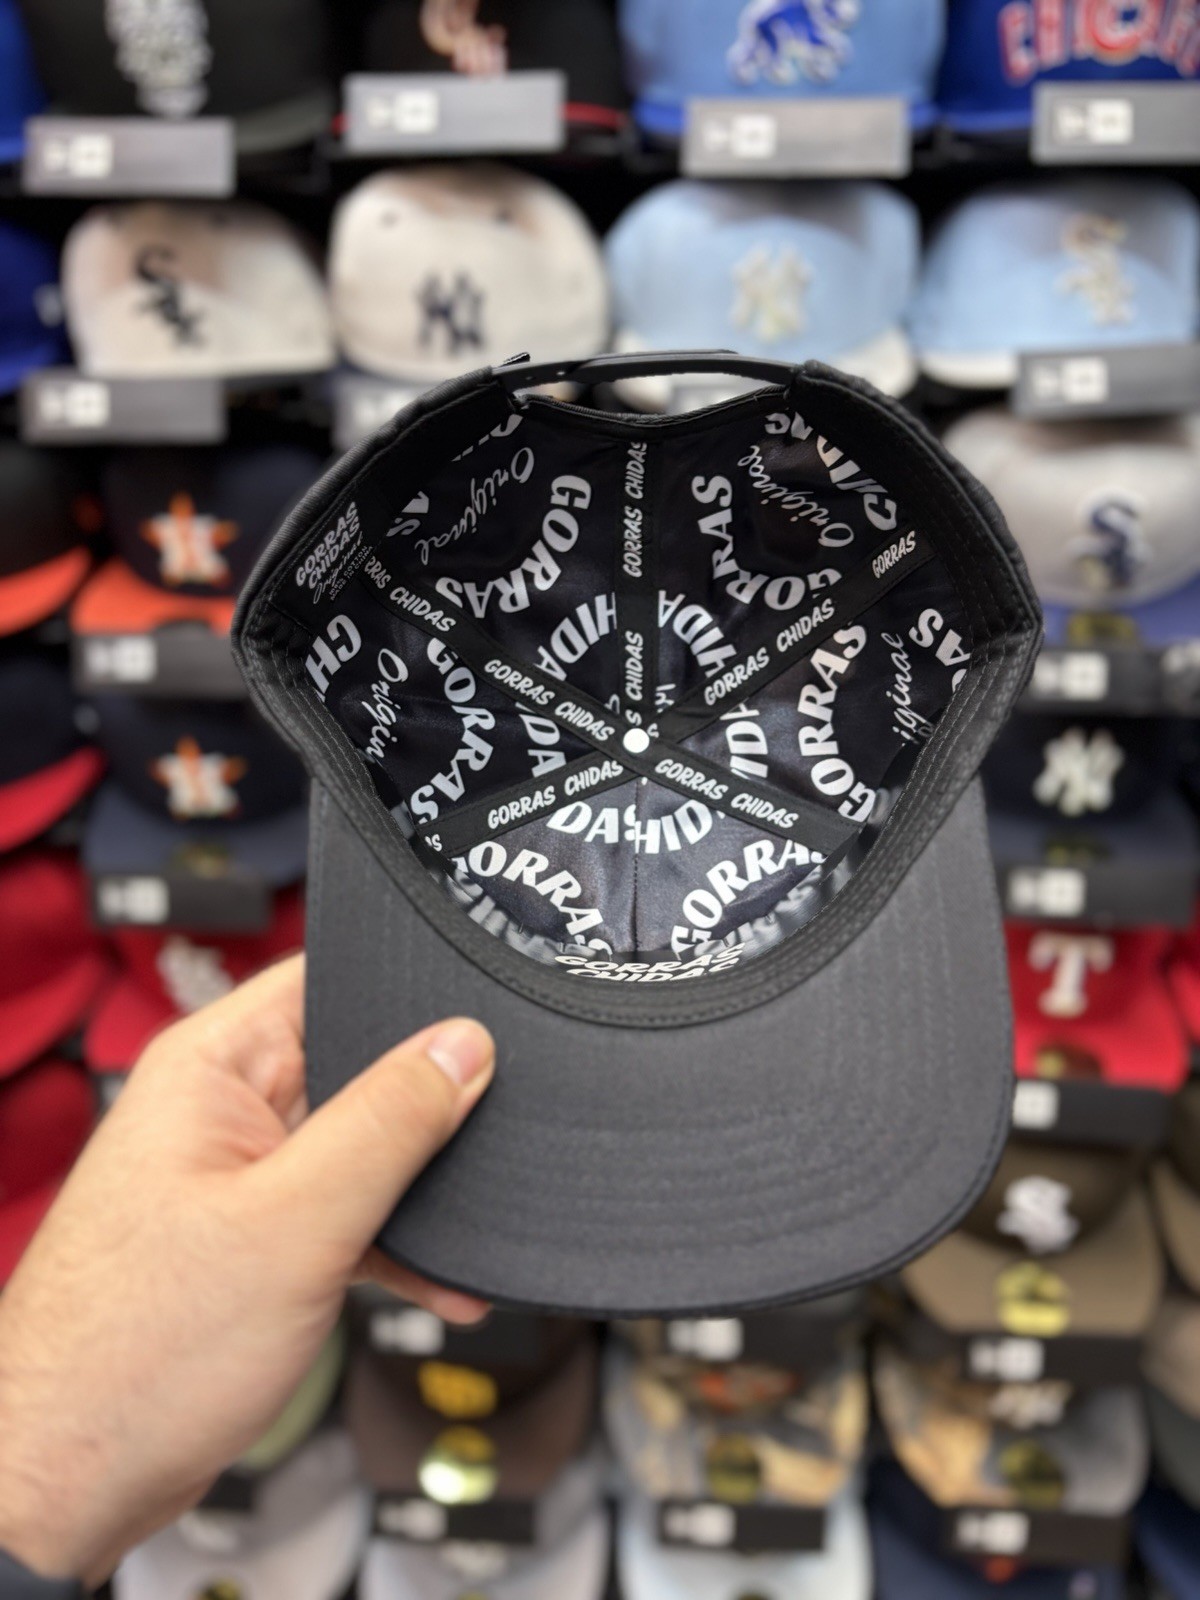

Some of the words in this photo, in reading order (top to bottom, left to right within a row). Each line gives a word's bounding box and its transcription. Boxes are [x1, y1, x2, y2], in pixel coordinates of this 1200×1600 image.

[414, 447, 535, 566] Original
[623, 441, 649, 500] CHIDAS
[295, 501, 358, 587] GORRAS
[308, 515, 361, 589] CHIDAS
[434, 474, 593, 620] GORRAS
[621, 506, 644, 578] GORRAS
[389, 586, 457, 633] CHIDAS
[484, 659, 556, 707] GORRAS
[554, 701, 616, 742] CHIDAS
[624, 630, 644, 701] CHIDAS
[703, 647, 771, 706] GORRAS
[775, 597, 836, 653] CHIDAS
[871, 530, 917, 579] GORRAS
[360, 648, 409, 759] Origin
[410, 637, 497, 825] GORRAS
[797, 624, 877, 823] GORRAS
[880, 632, 926, 747] iginal
[487, 786, 557, 830] GORRAS
[563, 760, 624, 796] CHIDAS
[655, 758, 729, 801] GORRAS
[730, 792, 799, 829] CHIDAS
[671, 839, 827, 961] GORRA
[554, 942, 746, 973] GORRAS
